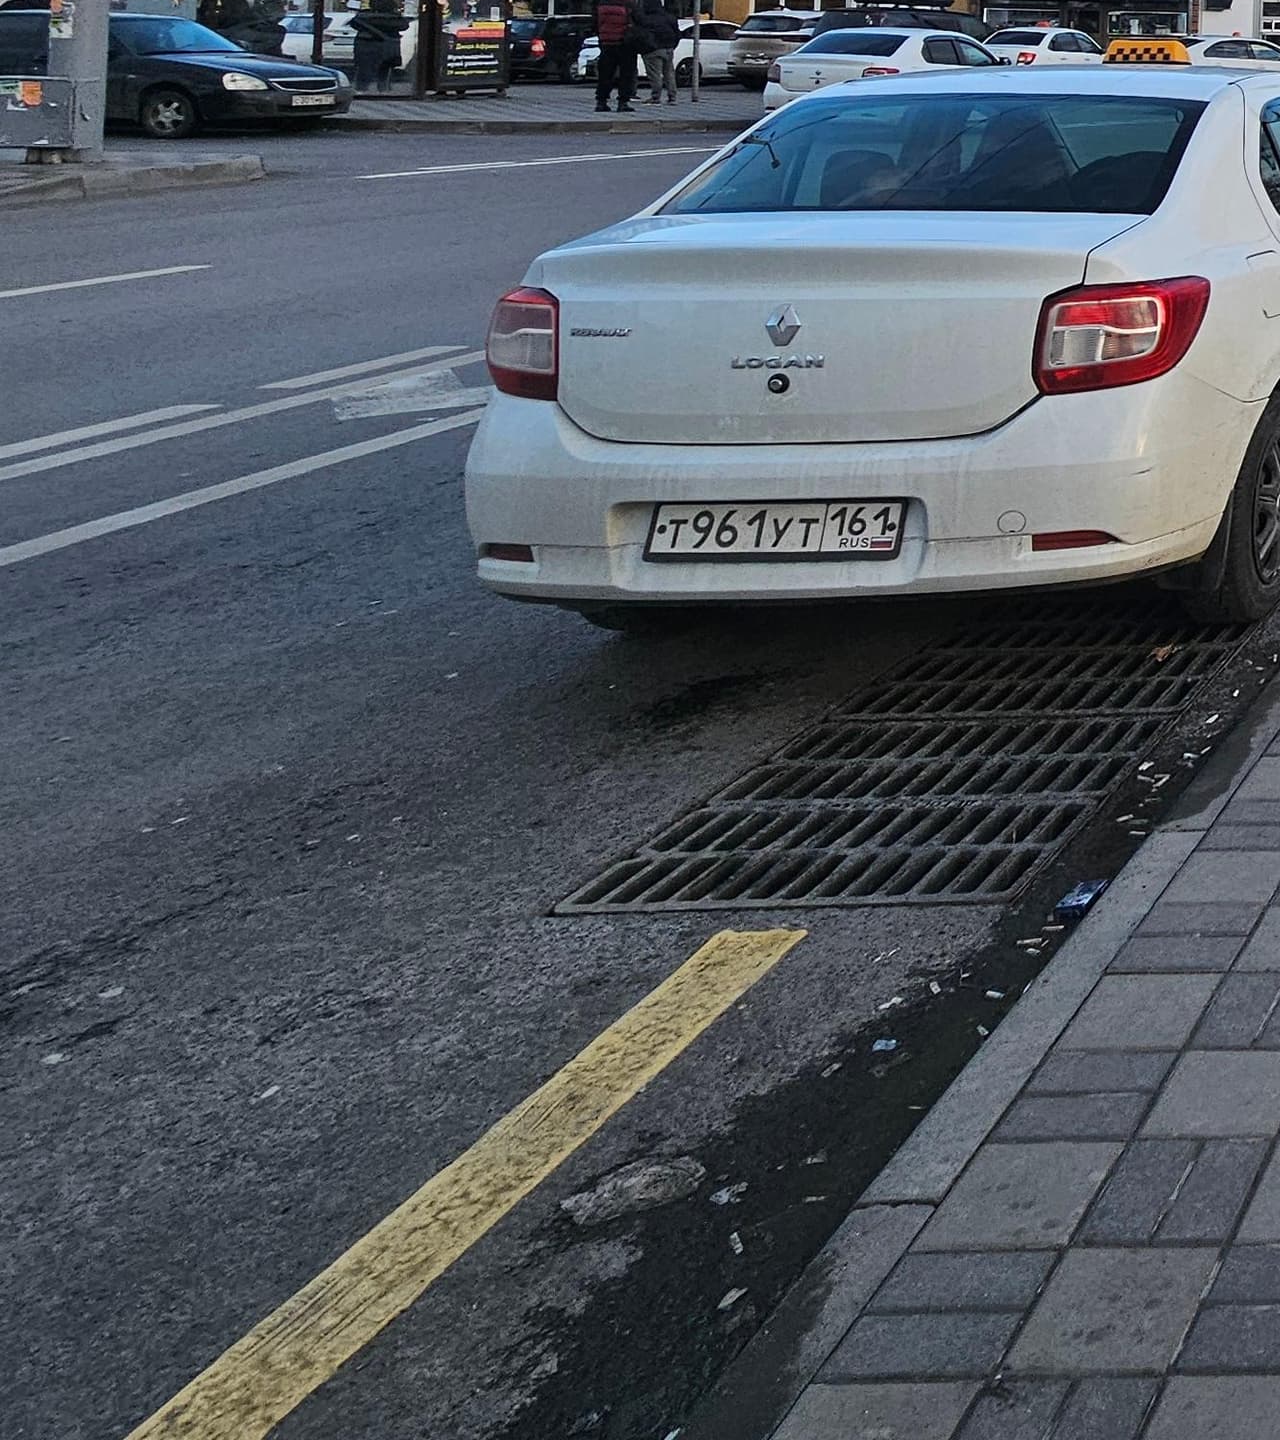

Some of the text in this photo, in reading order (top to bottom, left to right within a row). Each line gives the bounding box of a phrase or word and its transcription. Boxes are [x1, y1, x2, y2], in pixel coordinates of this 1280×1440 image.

[731, 355, 825, 369] LOGAN
[669, 507, 891, 548] Т961УТ 161
[839, 538, 869, 548] RUS
